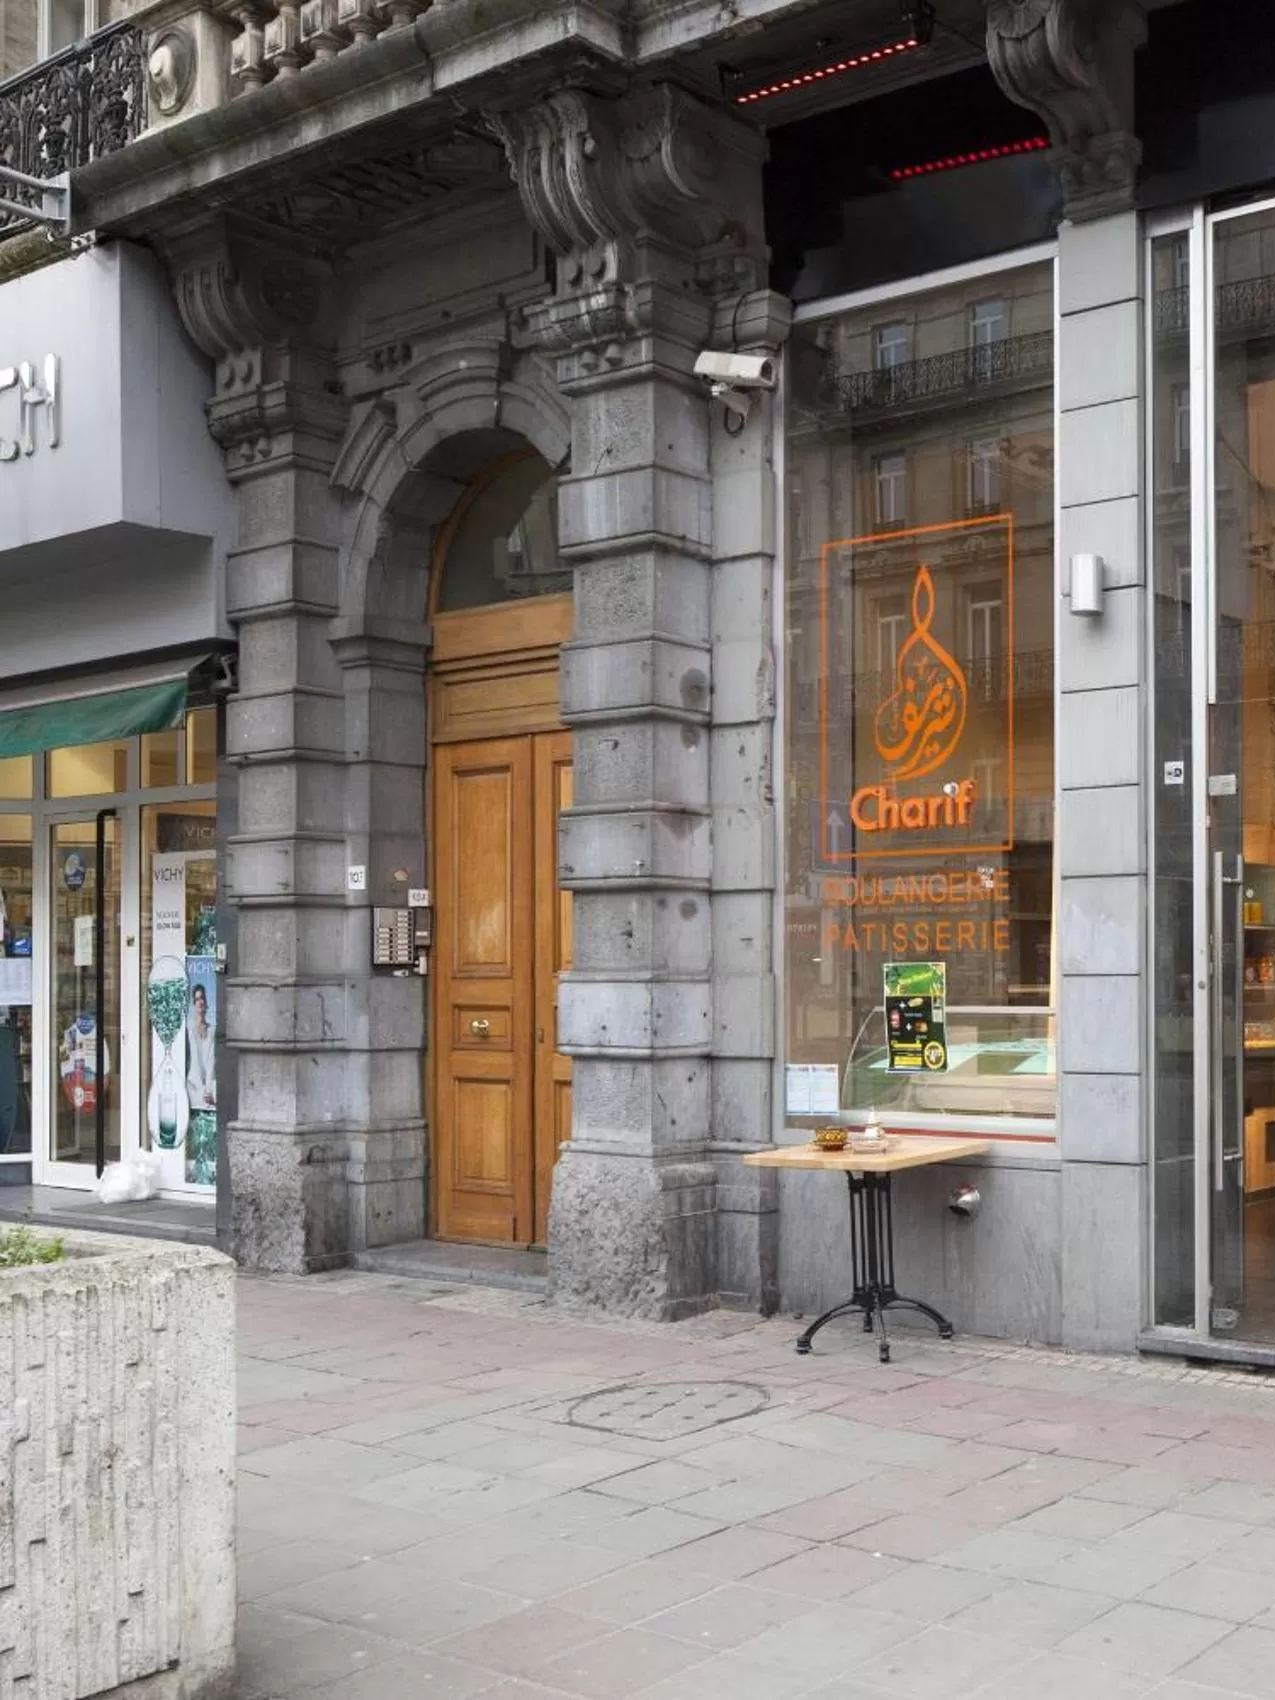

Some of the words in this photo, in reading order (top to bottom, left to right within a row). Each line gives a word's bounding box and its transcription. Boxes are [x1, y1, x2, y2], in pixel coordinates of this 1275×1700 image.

[850, 778, 976, 832] Charif
[184, 824, 216, 841] VIC
[154, 867, 184, 881] VICHY
[822, 867, 1011, 910] BOULANGERIE
[822, 916, 1011, 955] PATISSERIE
